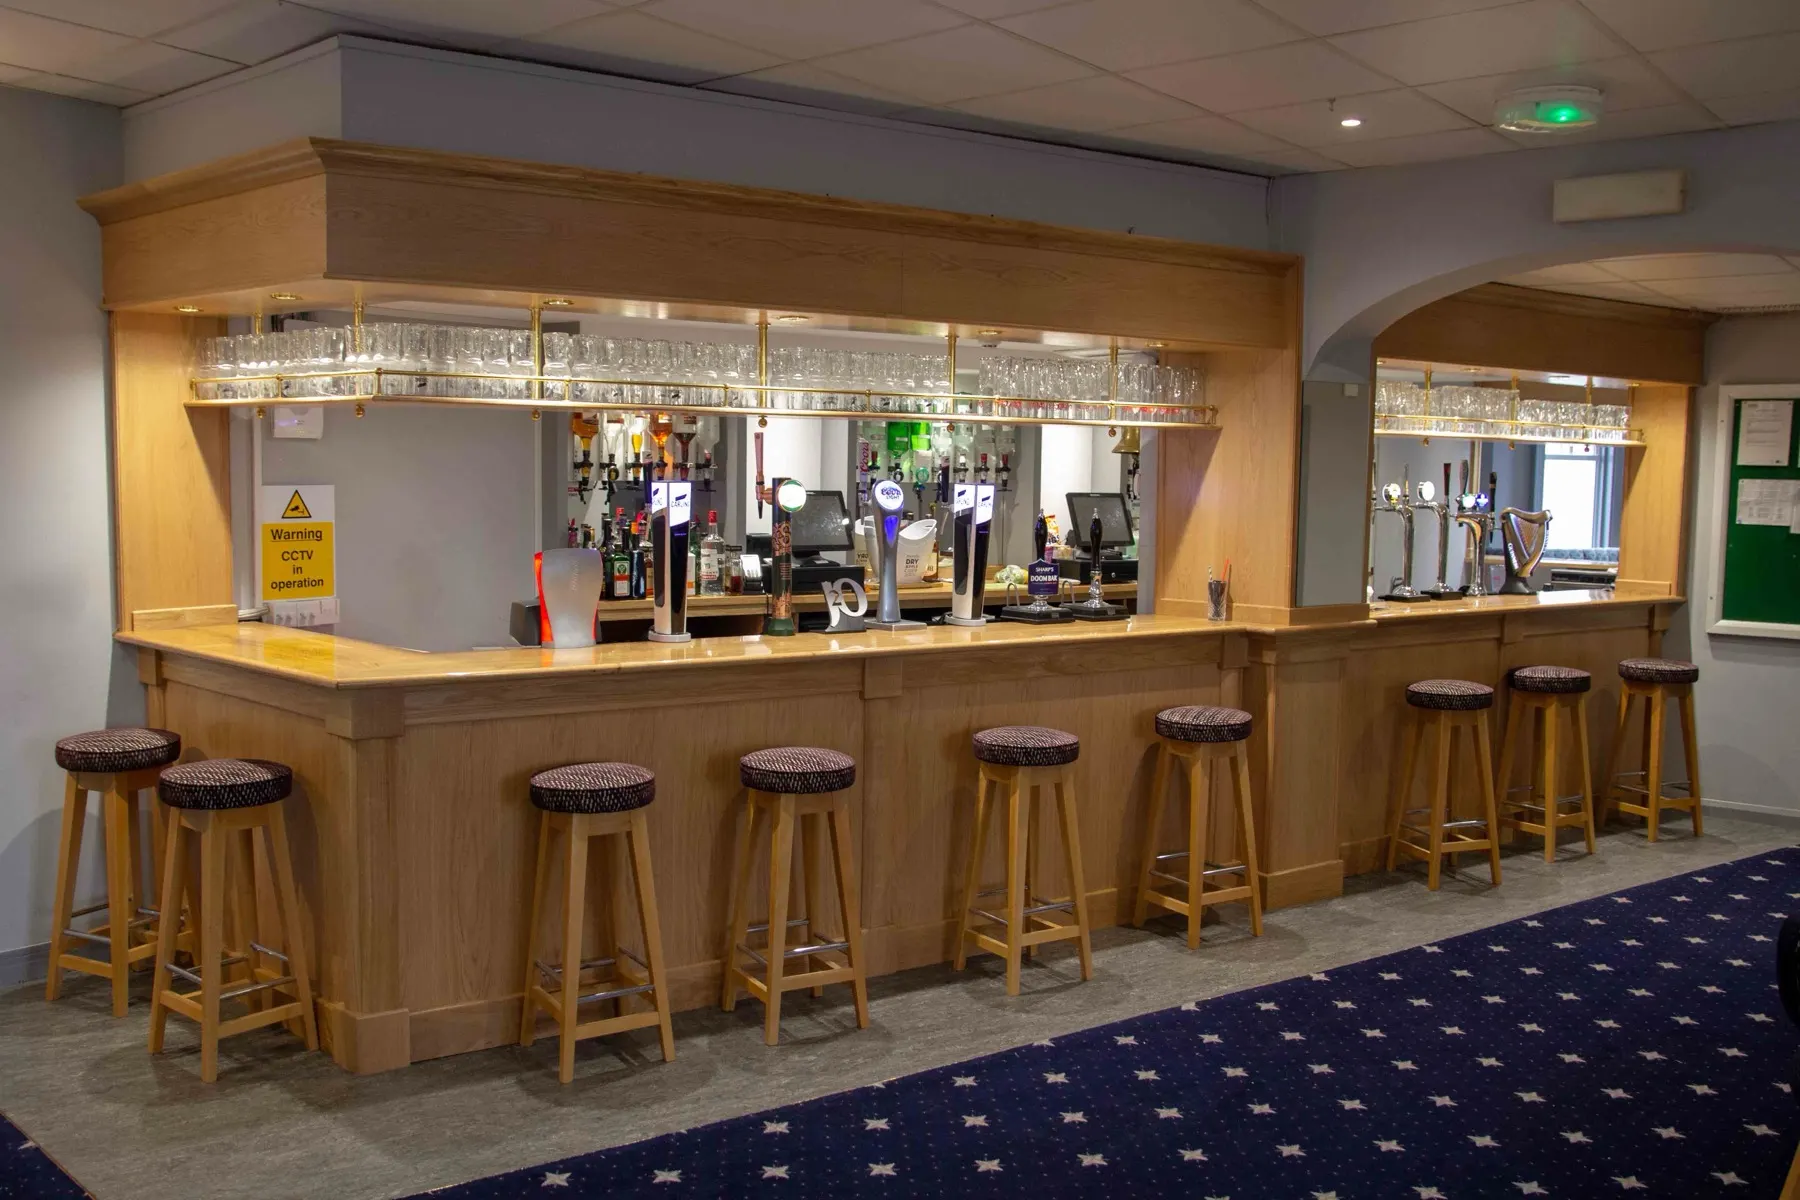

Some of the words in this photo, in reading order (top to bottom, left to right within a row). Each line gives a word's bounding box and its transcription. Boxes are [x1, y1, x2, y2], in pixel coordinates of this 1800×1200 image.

[861, 442, 869, 472] Coors
[271, 528, 323, 542] Warning
[281, 550, 314, 561] CCTV
[292, 565, 303, 574] in
[270, 578, 324, 592] operation
